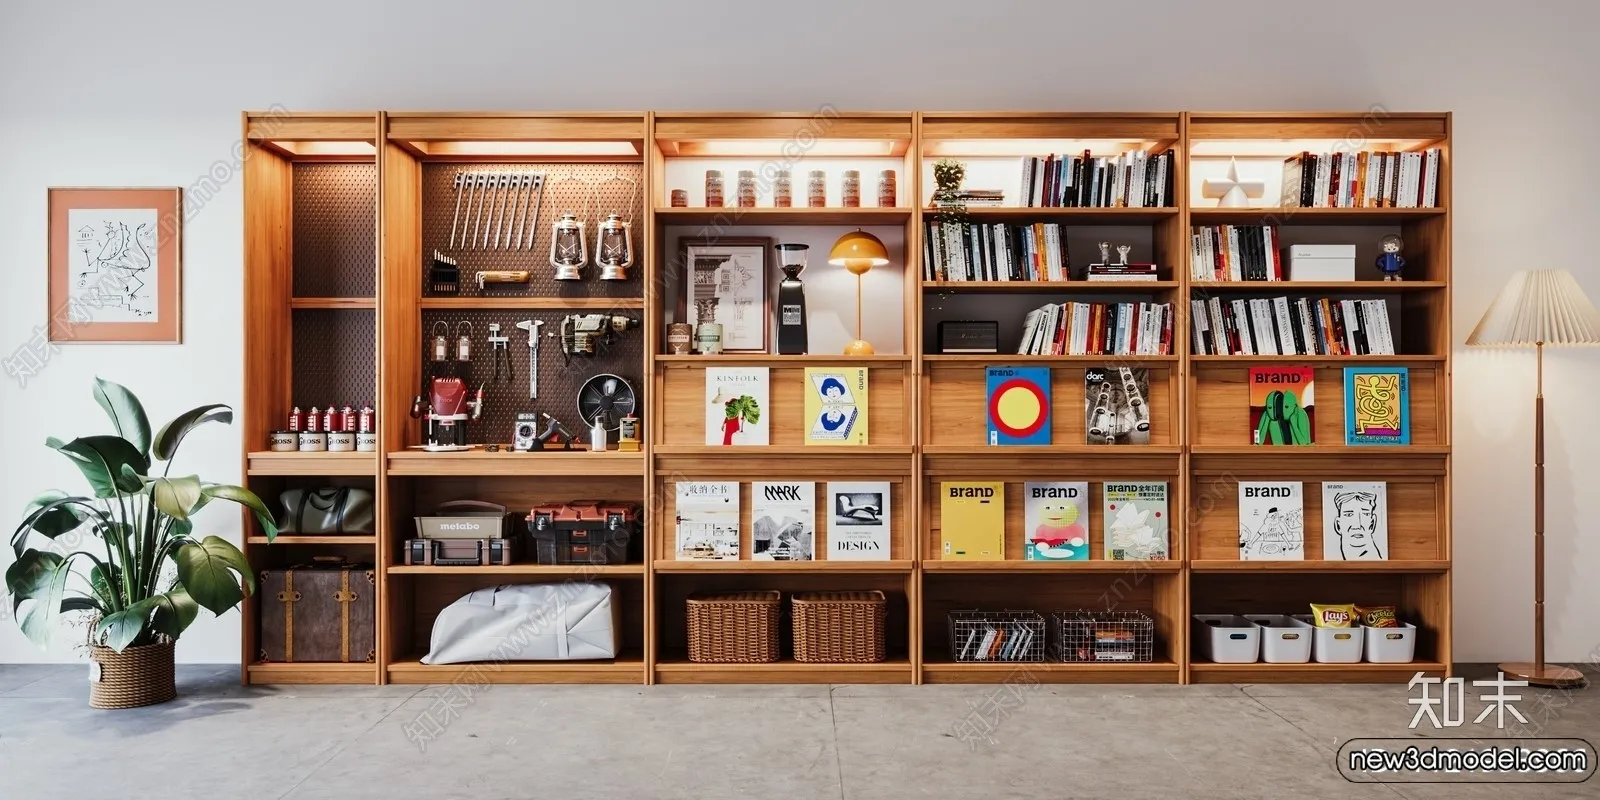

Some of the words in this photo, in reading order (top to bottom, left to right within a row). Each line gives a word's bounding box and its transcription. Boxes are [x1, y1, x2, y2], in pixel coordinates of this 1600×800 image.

[1086, 371, 1105, 380] darc
[689, 484, 728, 495] 收纳全书
[764, 485, 801, 501] MARK
[439, 522, 480, 530] metabo
[837, 540, 880, 551] DESIGN
